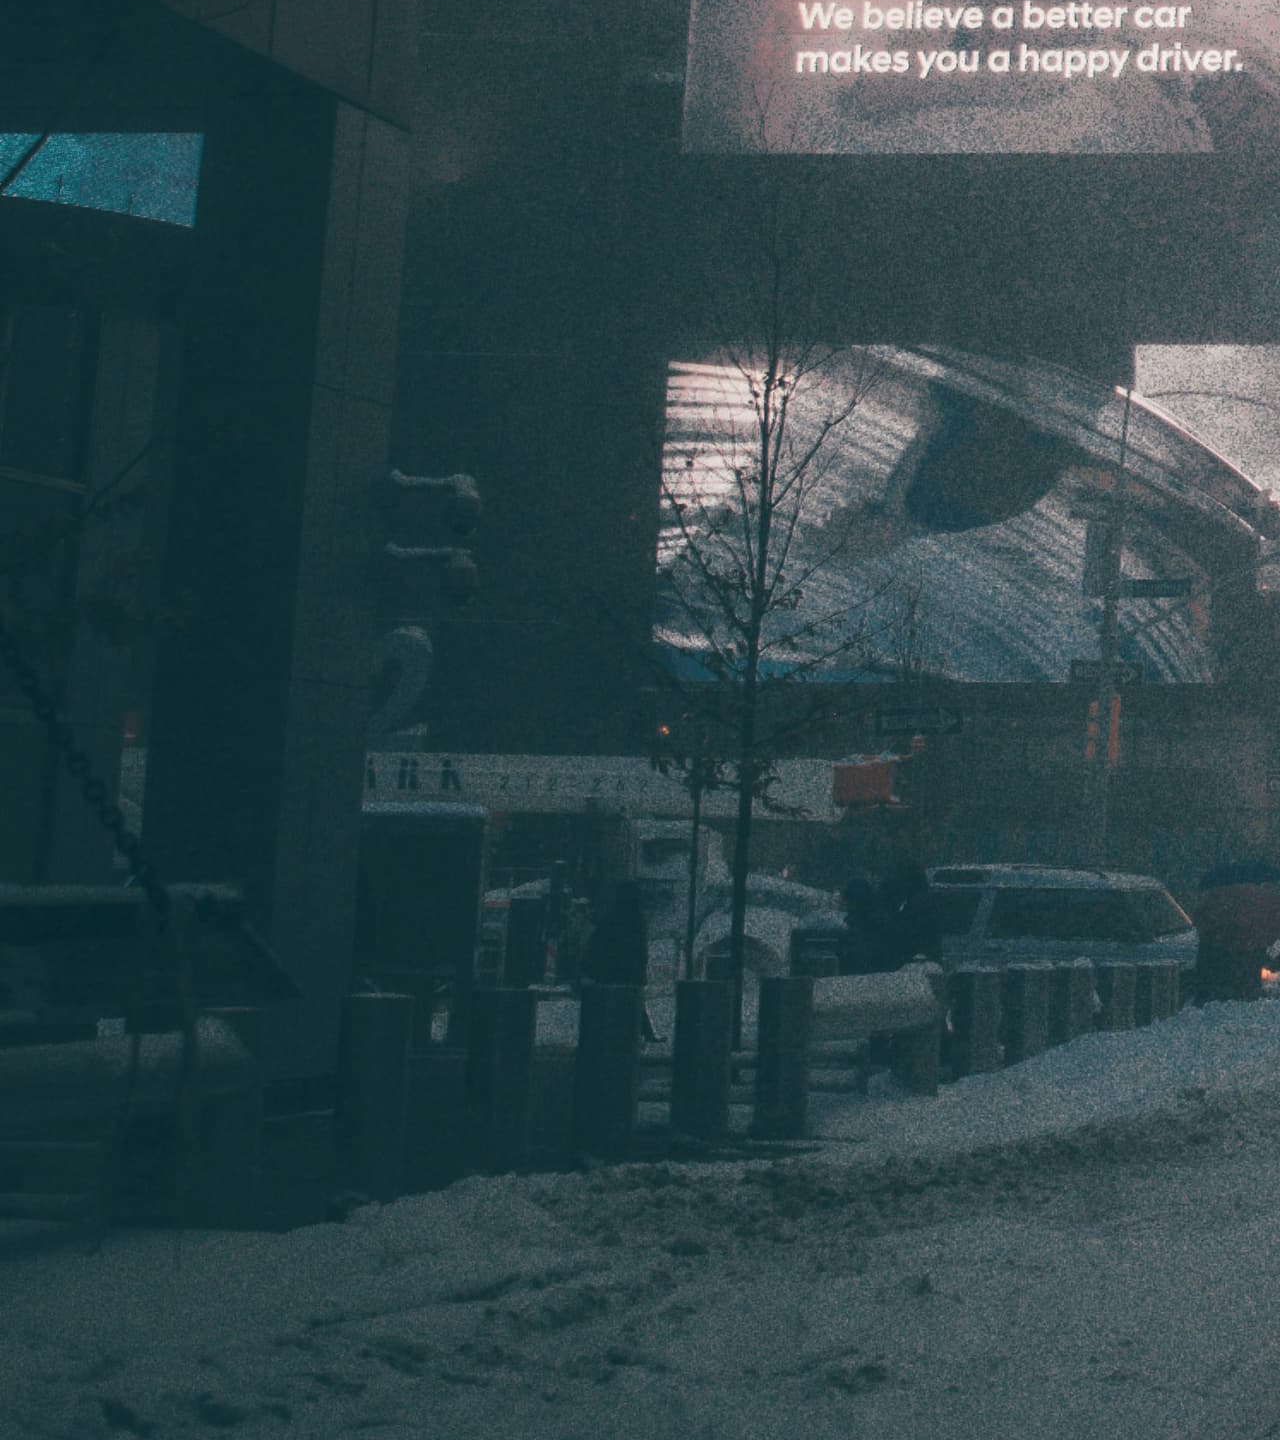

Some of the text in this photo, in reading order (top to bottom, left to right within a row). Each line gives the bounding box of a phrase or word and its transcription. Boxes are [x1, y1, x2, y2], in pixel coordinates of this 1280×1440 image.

[798, 0, 1192, 30] We believe a better car
[796, 42, 1244, 79] makes you a happy driver.
